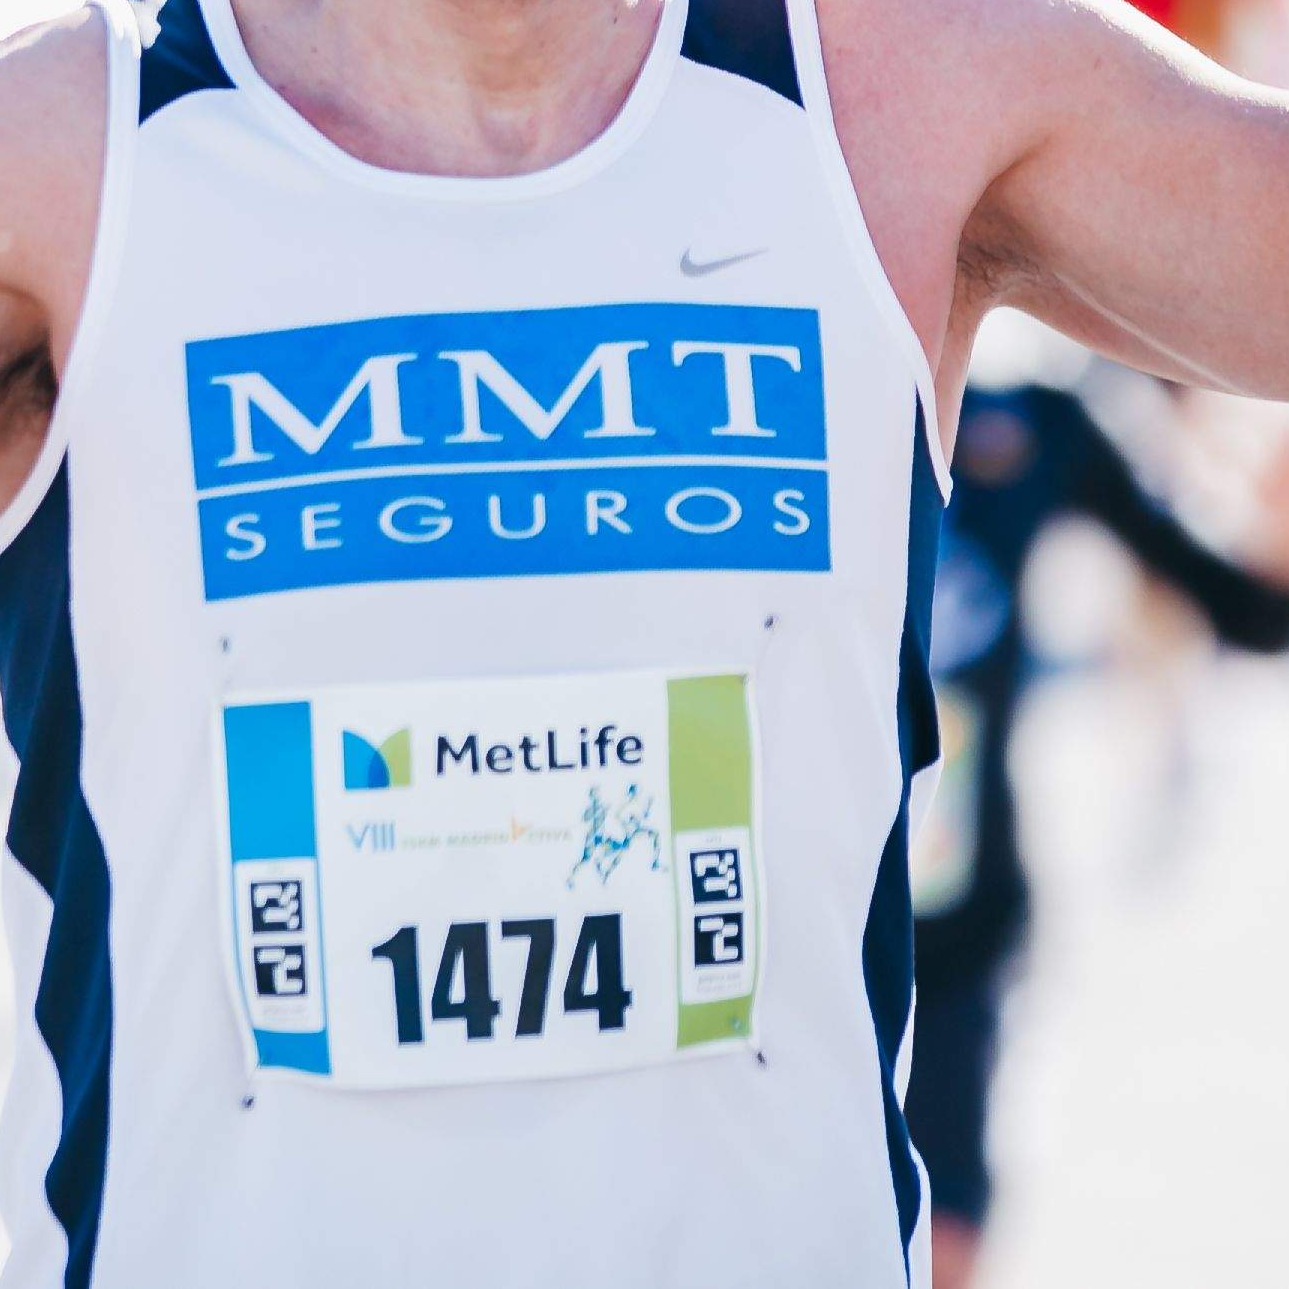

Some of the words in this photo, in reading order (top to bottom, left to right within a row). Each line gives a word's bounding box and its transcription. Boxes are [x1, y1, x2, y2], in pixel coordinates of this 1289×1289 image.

[210, 340, 803, 467] MMT
[225, 487, 812, 561] SEGUROS
[436, 724, 643, 776] MetLife
[345, 820, 396, 852] VIII
[371, 913, 632, 1044] 1474
